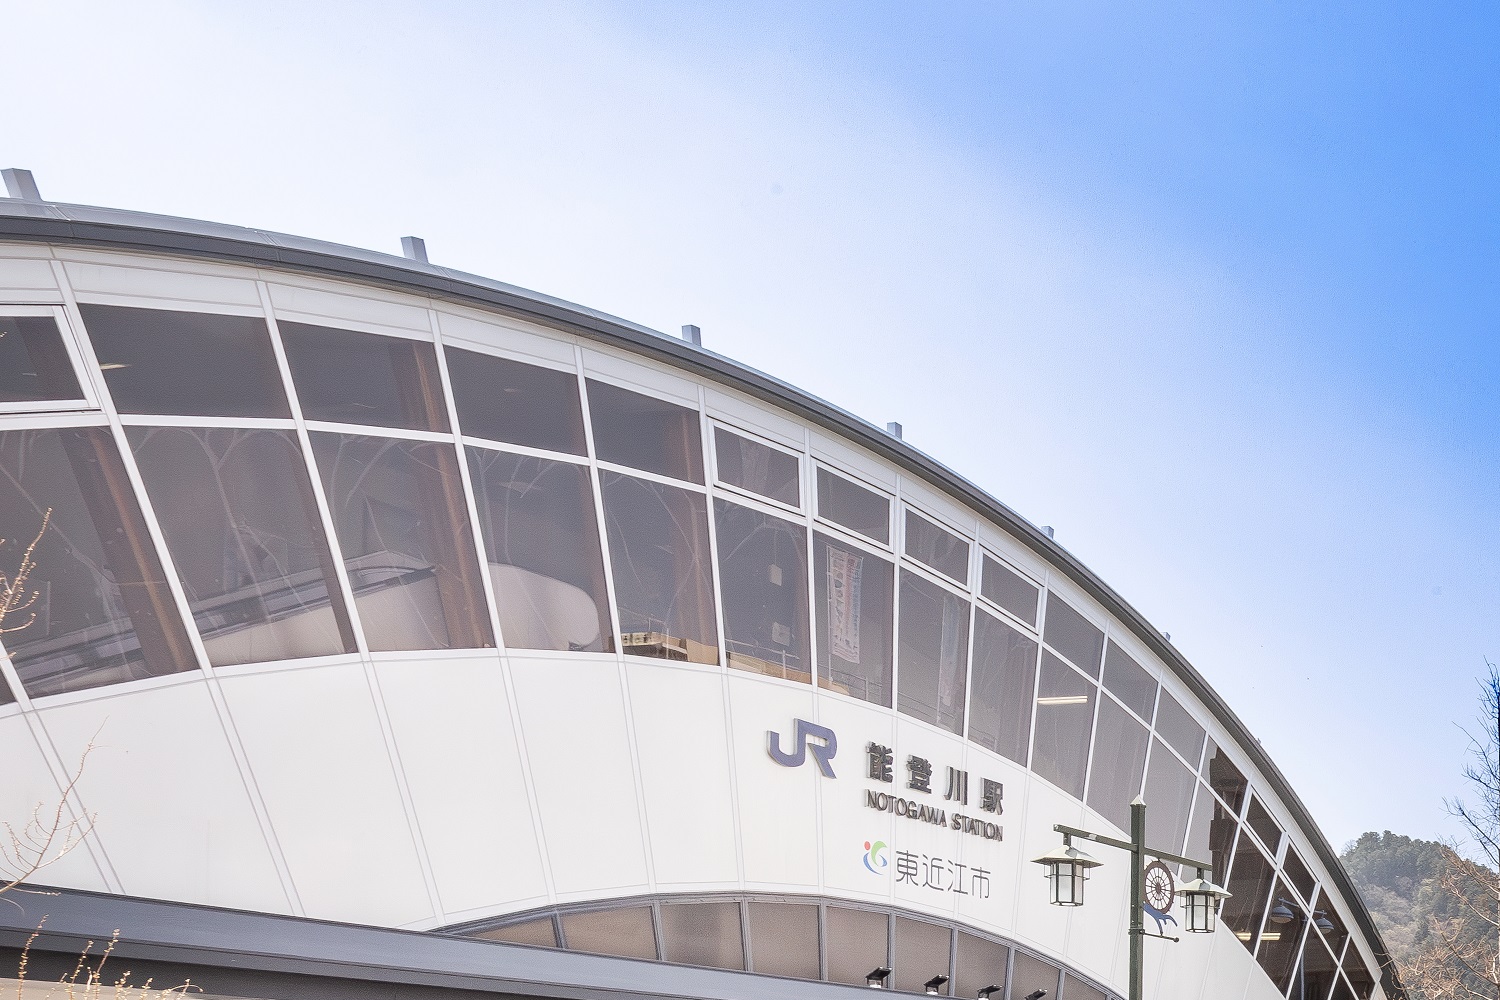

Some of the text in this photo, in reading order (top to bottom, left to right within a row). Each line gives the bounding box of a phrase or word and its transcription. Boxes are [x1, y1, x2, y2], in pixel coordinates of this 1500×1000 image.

[766, 718, 837, 779] JR
[866, 741, 1004, 815] 能登川駅
[864, 789, 1003, 841] NOTOGAWA STATION
[895, 850, 991, 899] 東近江市
